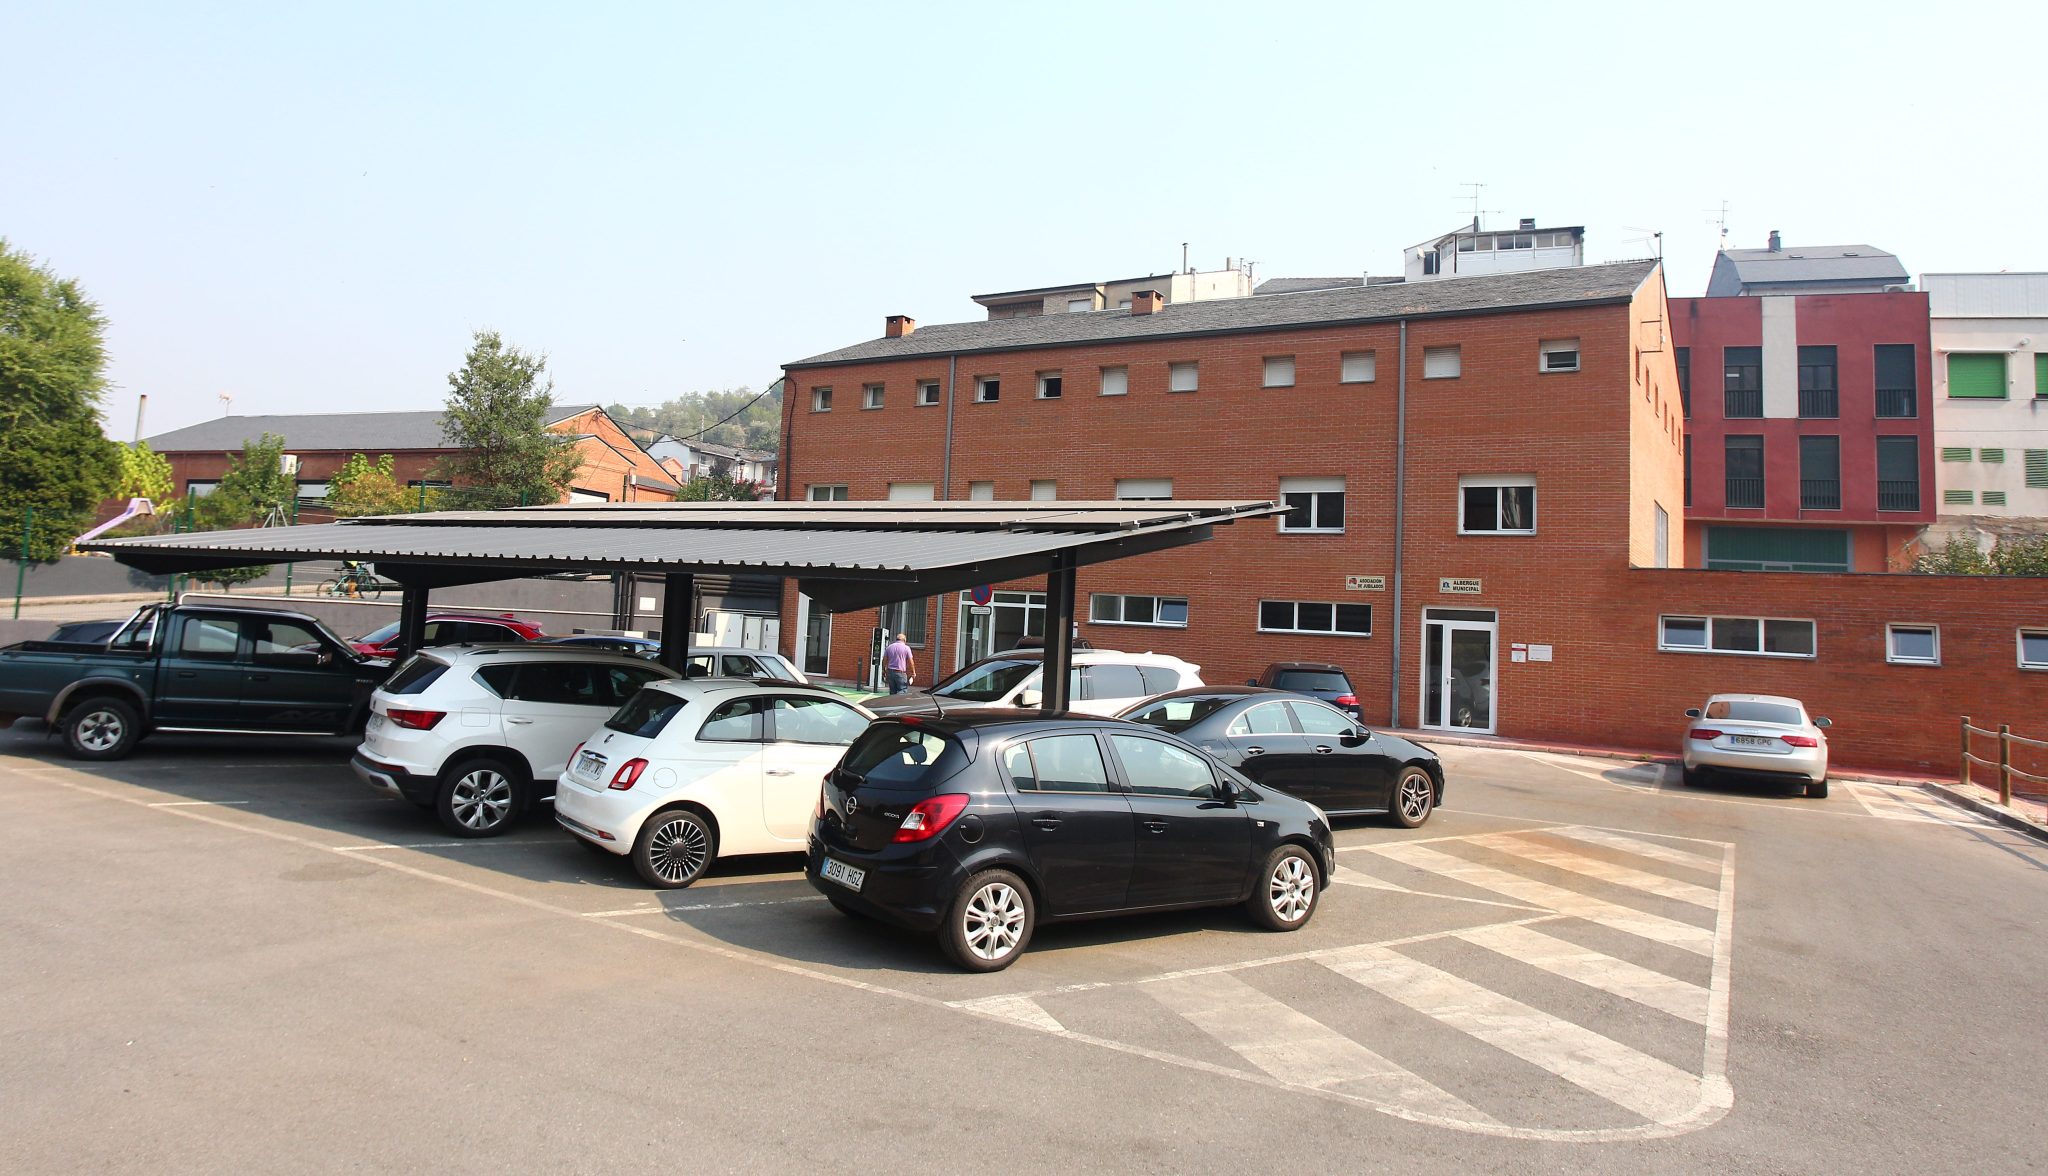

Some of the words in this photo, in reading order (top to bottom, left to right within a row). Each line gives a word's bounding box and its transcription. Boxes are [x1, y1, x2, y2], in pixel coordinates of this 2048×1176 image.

[1735, 736, 1755, 745] 6858
[1757, 738, 1772, 746] GPG
[827, 861, 846, 879] 3091
[846, 868, 863, 886] HGZ
